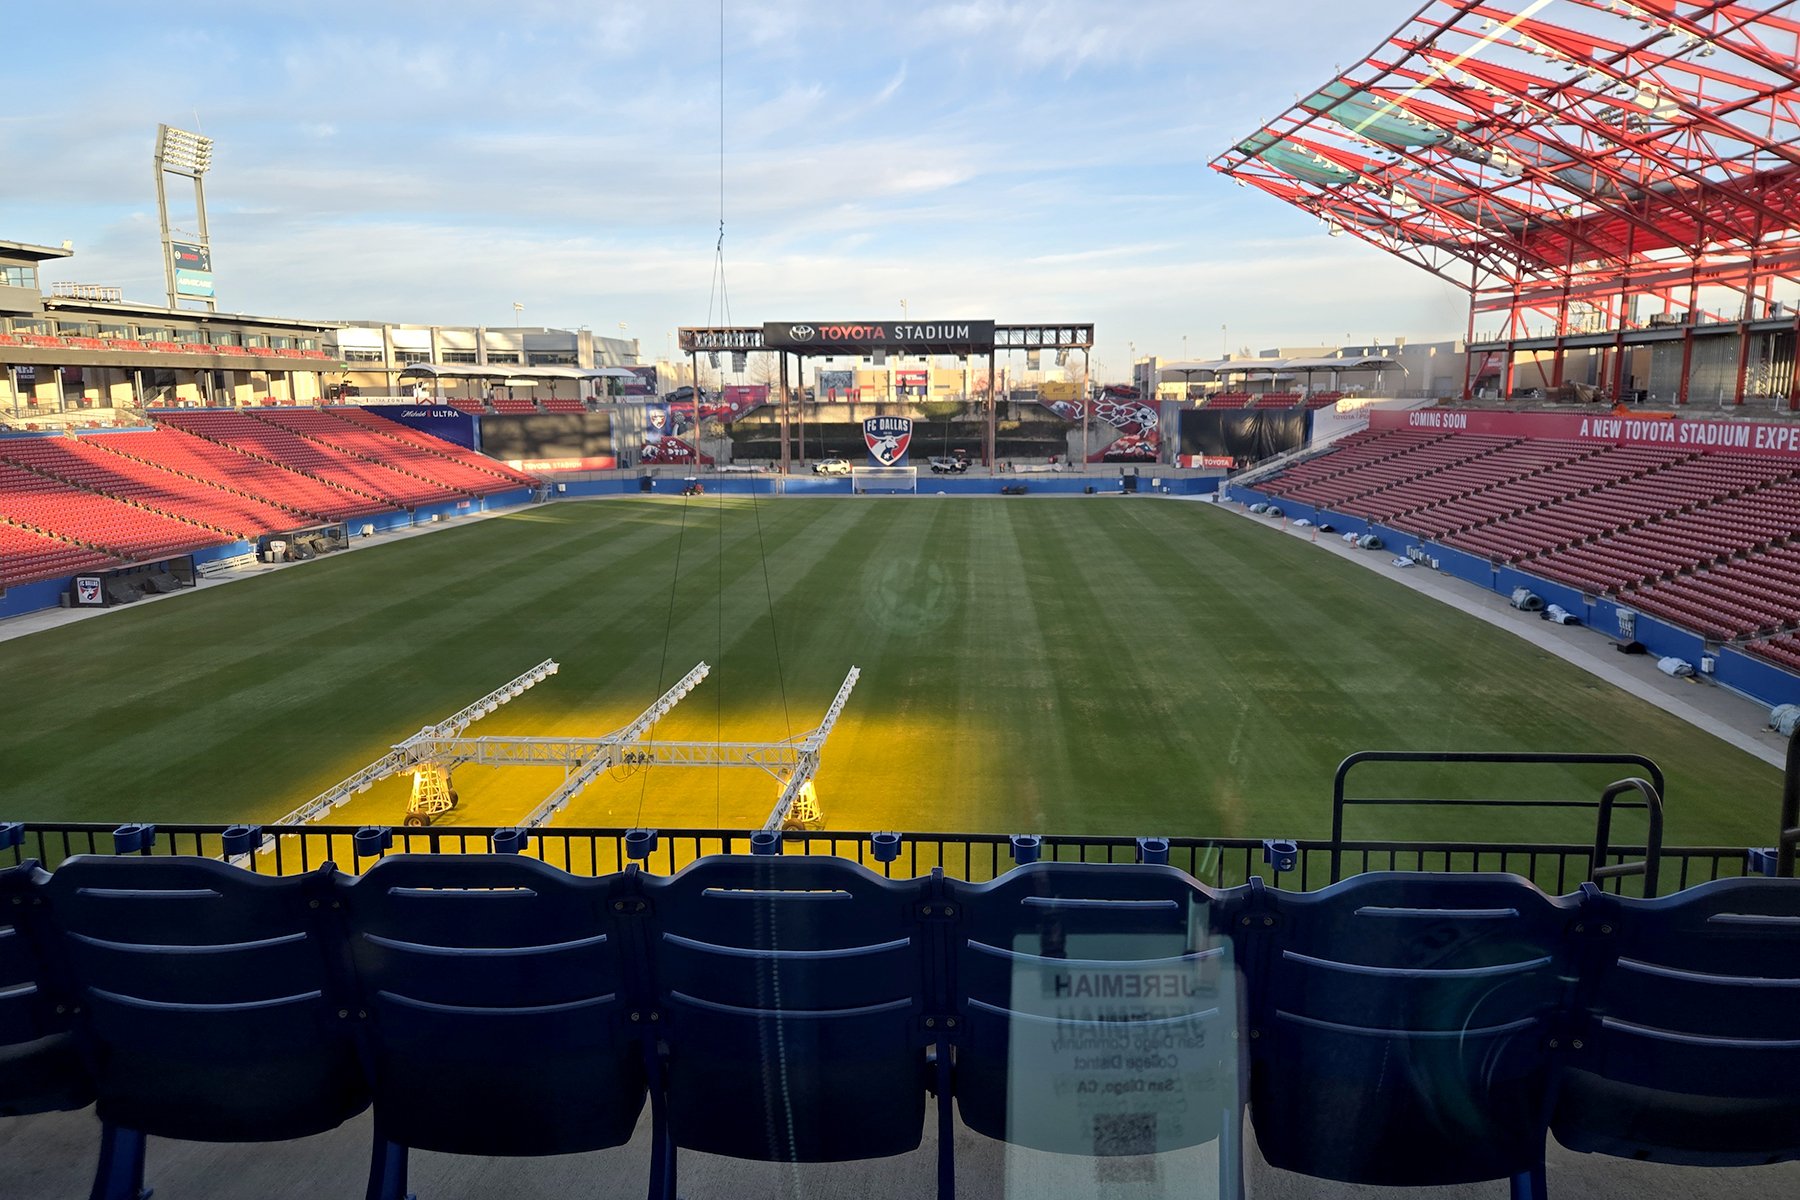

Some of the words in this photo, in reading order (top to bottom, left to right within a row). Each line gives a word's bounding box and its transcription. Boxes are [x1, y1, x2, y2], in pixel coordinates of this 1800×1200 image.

[818, 326, 886, 340] TOYOTA
[894, 325, 969, 340] STADIUM
[433, 410, 459, 418] ULTRA
[1409, 411, 1441, 428] COMING
[1443, 412, 1467, 429] SOON
[867, 419, 877, 432] FC
[880, 418, 908, 432] DALLAS
[1580, 418, 1589, 437] A
[1593, 419, 1622, 439] NEW
[1625, 420, 1675, 443] TOYOTA
[1679, 423, 1750, 447] STADIUM
[1755, 426, 1800, 451] EXPE
[1204, 458, 1230, 466] TOYOTA
